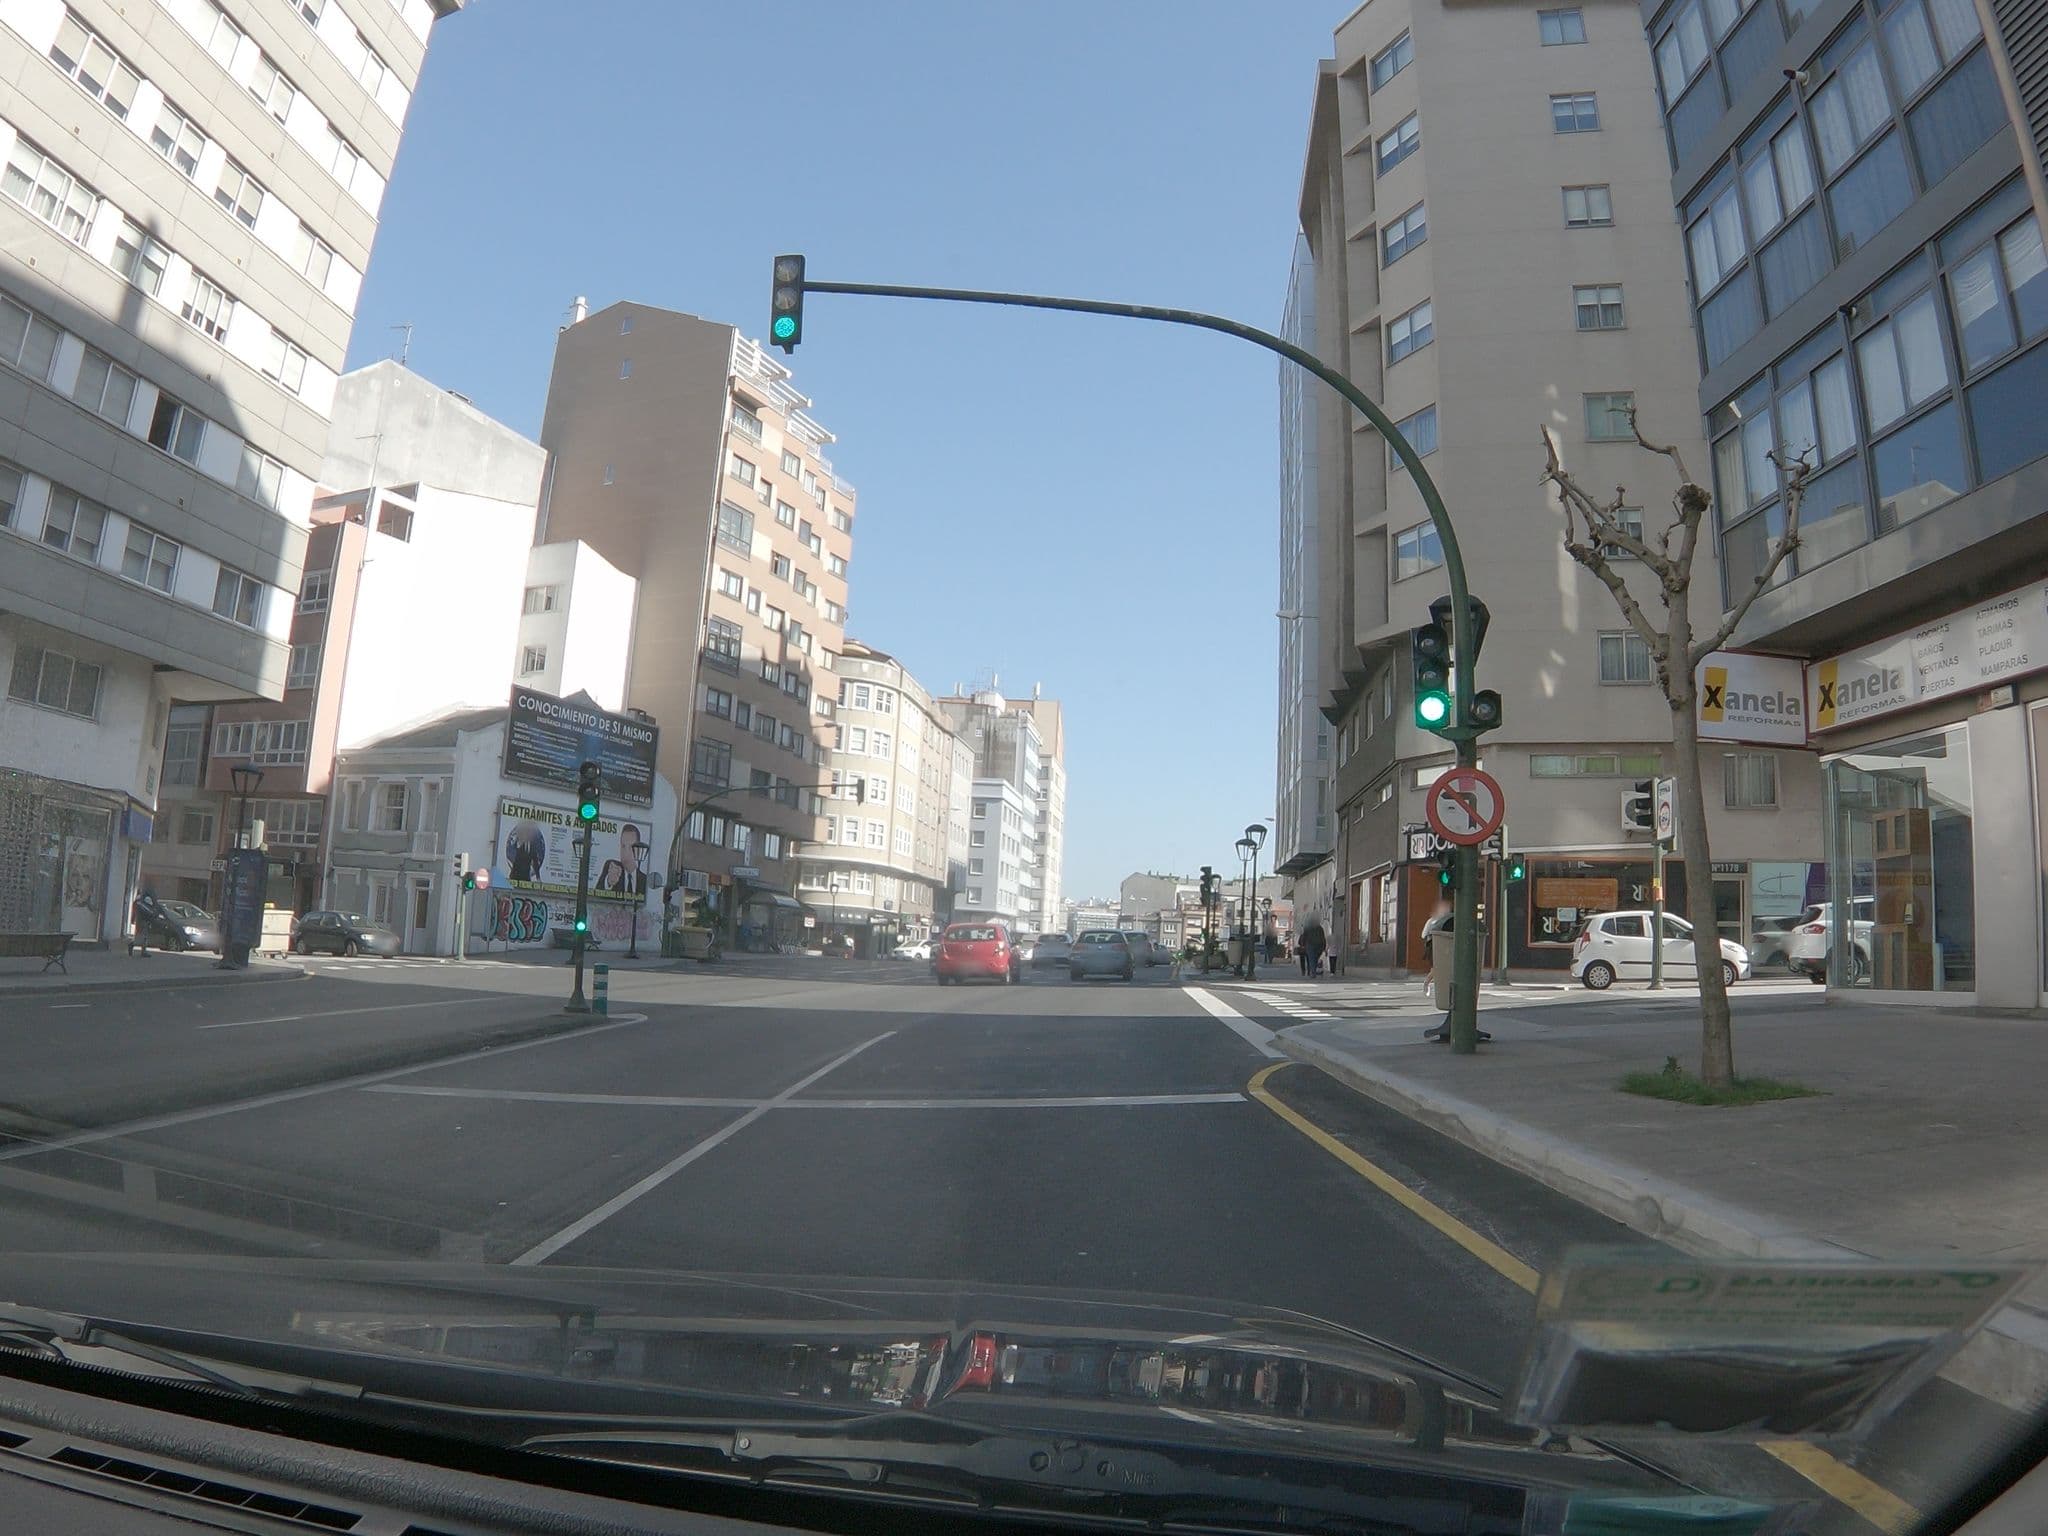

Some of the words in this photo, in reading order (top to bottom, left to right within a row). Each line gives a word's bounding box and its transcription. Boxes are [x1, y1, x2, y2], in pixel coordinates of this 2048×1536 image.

[1977, 618, 2014, 638] TARIMAS
[1979, 638, 2013, 657] PLADUR
[1918, 655, 1960, 676] VENTANAS
[1981, 653, 2029, 677] MAMPARAS
[1818, 667, 1904, 713] Xanela
[1920, 676, 1956, 695] PUERTAS
[1703, 685, 1800, 716] Xanela
[1838, 694, 1907, 721] REFORMAS
[518, 695, 597, 727] CONOCIMIENTO
[598, 717, 611, 732] DE
[612, 720, 621, 735] SI
[622, 725, 653, 743] MISMO
[1727, 714, 1801, 727] REFORMAS
[502, 802, 563, 825] LEXTRÁMITES
[565, 814, 572, 826] &
